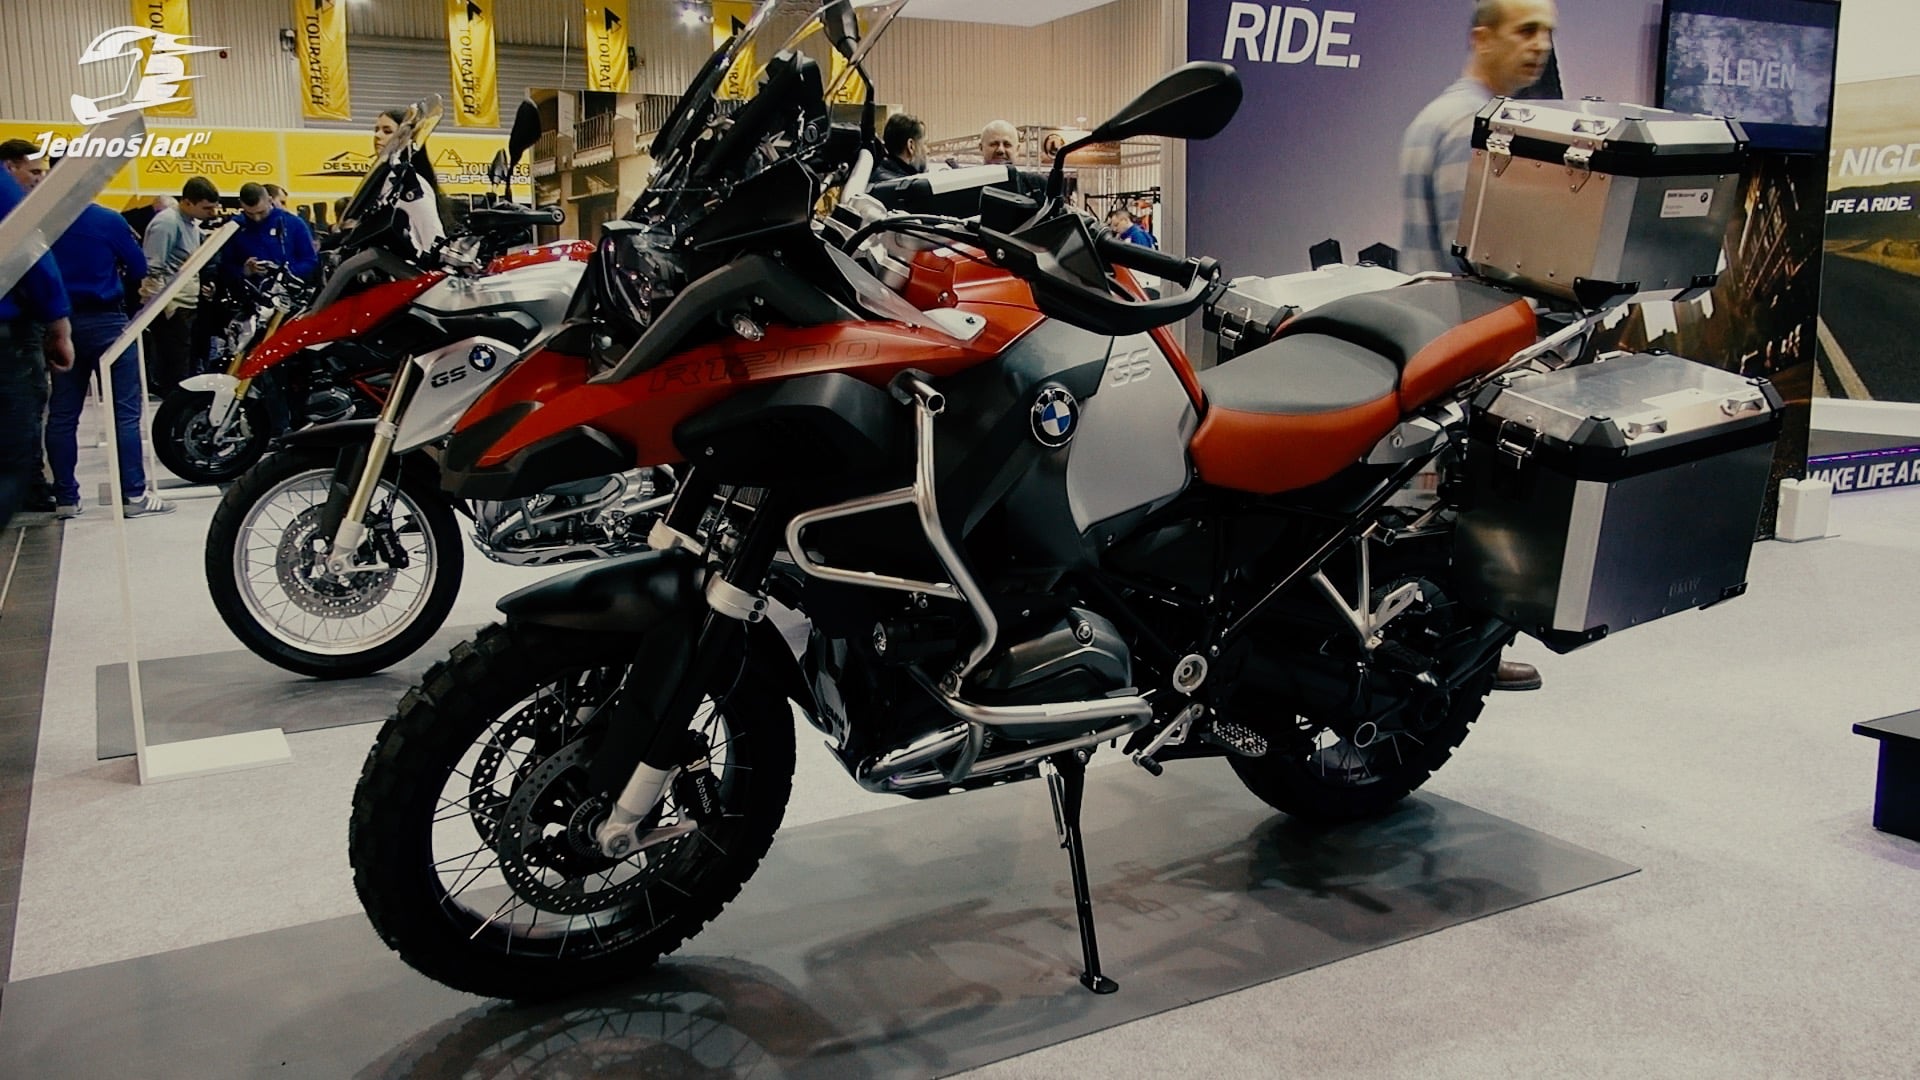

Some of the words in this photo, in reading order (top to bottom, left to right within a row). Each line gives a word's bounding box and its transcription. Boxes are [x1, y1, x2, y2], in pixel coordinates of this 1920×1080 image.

[1222, 1, 1361, 69] RIDE.
[306, 13, 324, 105] TOURATECH
[459, 26, 475, 115] TOURATECH
[1706, 57, 1796, 91] ELEVEN
[146, 159, 273, 175] AVENTURO
[1855, 198, 1869, 213] A
[1870, 196, 1912, 212] RIDE.
[431, 365, 467, 389] GS
[648, 337, 881, 393] R1200
[1106, 347, 1151, 388] GS
[1035, 388, 1074, 413] BMW
[1857, 462, 1896, 489] LIFE
[1894, 460, 1909, 484] A
